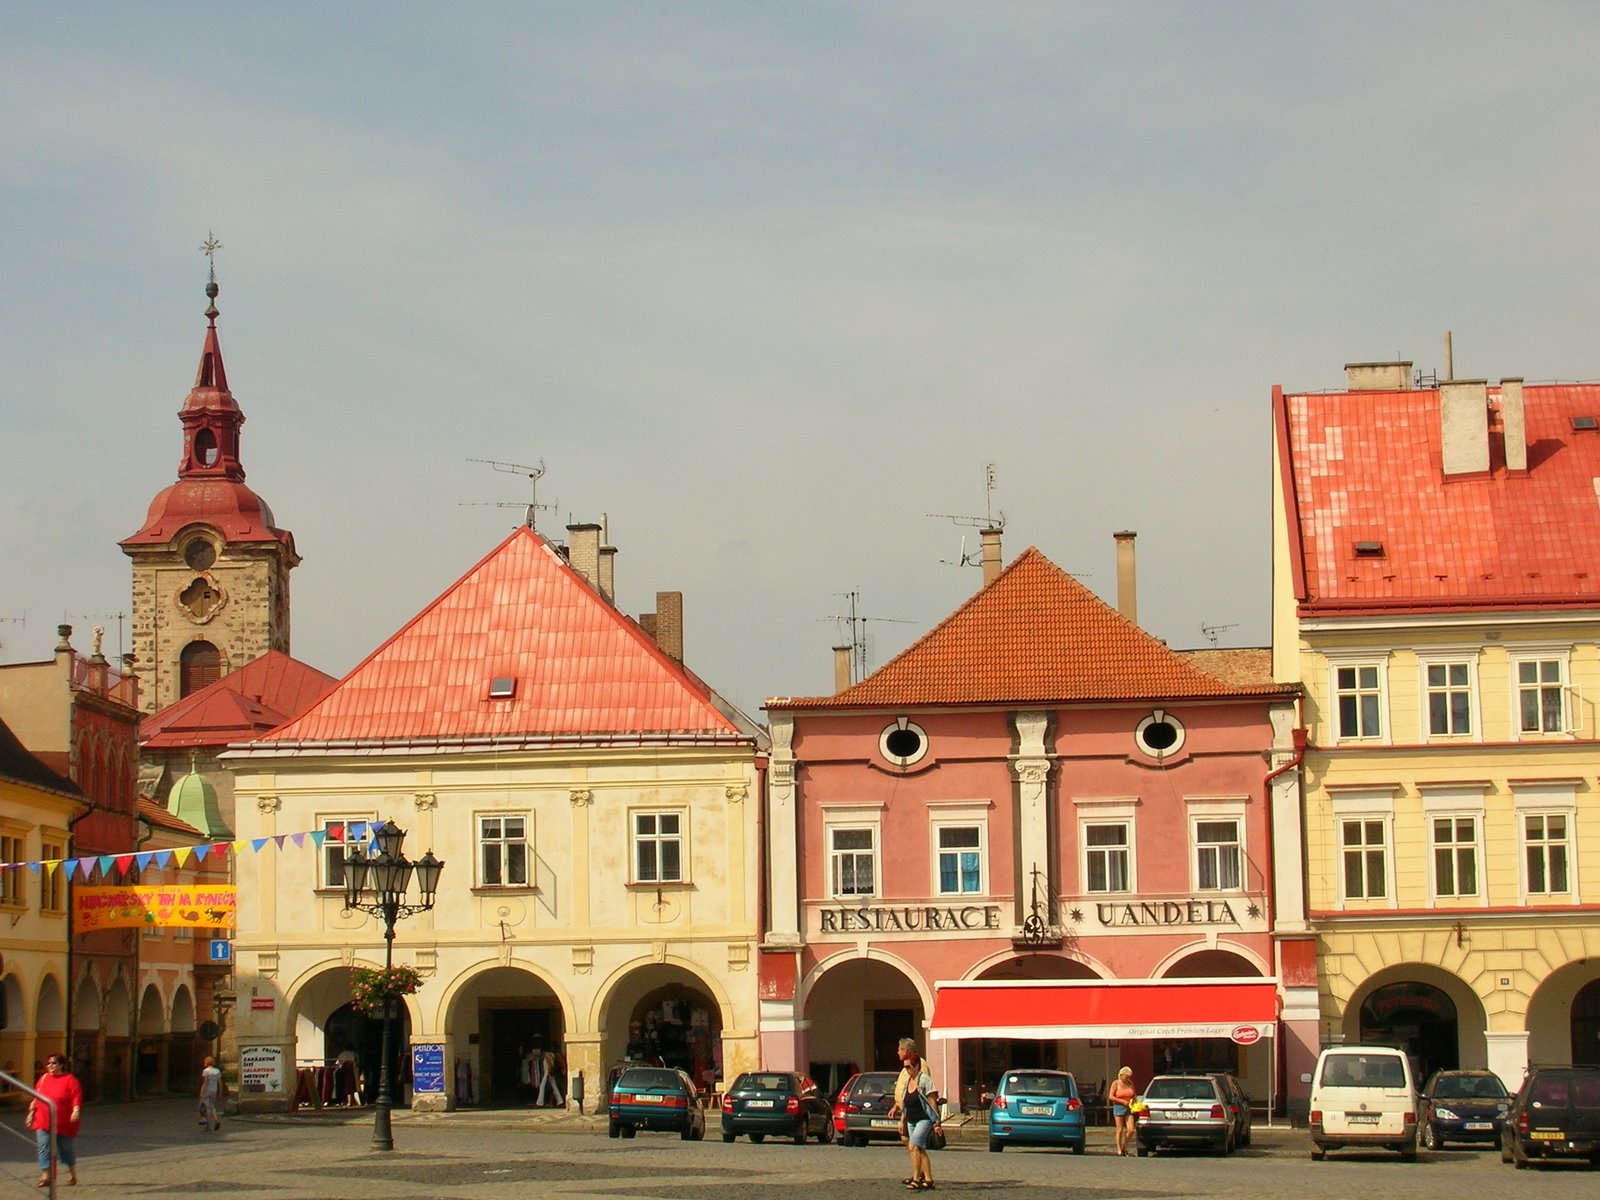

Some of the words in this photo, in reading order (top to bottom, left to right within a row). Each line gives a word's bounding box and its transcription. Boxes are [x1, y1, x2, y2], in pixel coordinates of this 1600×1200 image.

[820, 906, 1000, 931] RESTAURACE
[1096, 903, 1113, 924] U
[1128, 1027, 1155, 1036] Original
[1157, 1027, 1175, 1035] Czech
[1177, 1026, 1205, 1034] Premium
[1206, 1026, 1225, 1035] Lager
